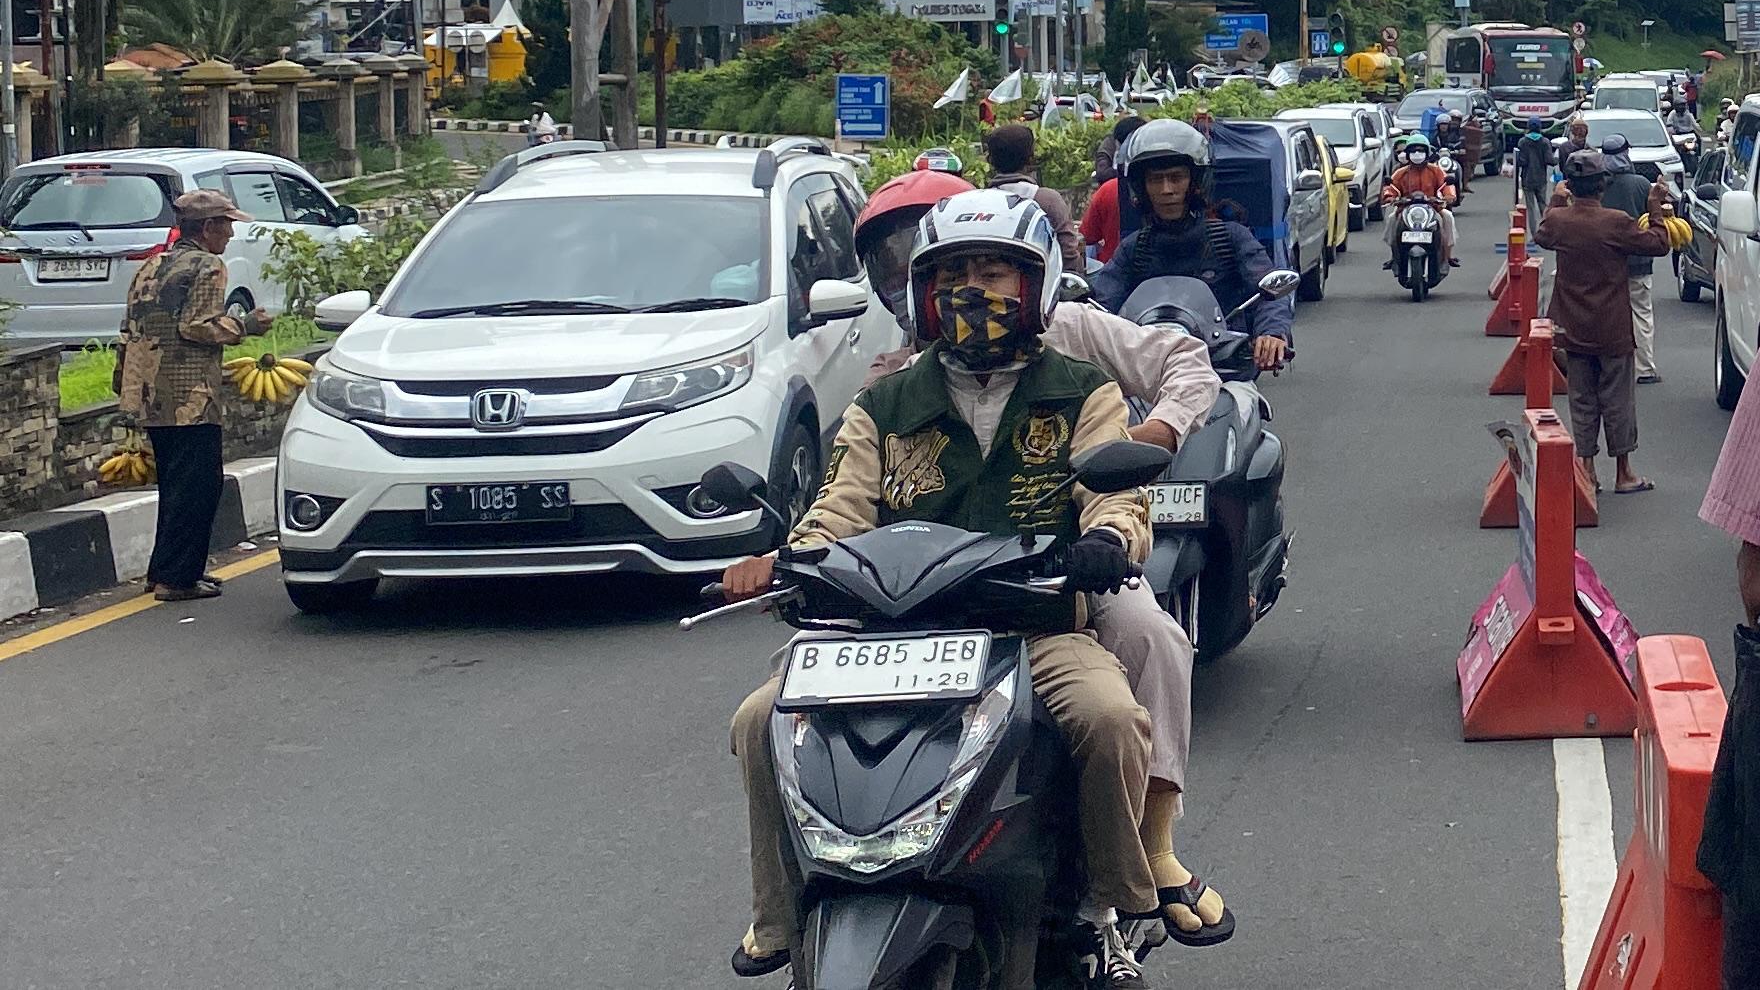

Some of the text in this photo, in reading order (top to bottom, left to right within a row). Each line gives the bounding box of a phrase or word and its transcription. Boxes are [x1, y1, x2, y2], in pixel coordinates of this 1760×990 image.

[954, 212, 995, 223] GM
[469, 486, 518, 510] 1085
[1173, 487, 1203, 504] UCF
[891, 525, 931, 533] HONDA
[802, 646, 819, 670] B
[835, 642, 910, 667] 6685
